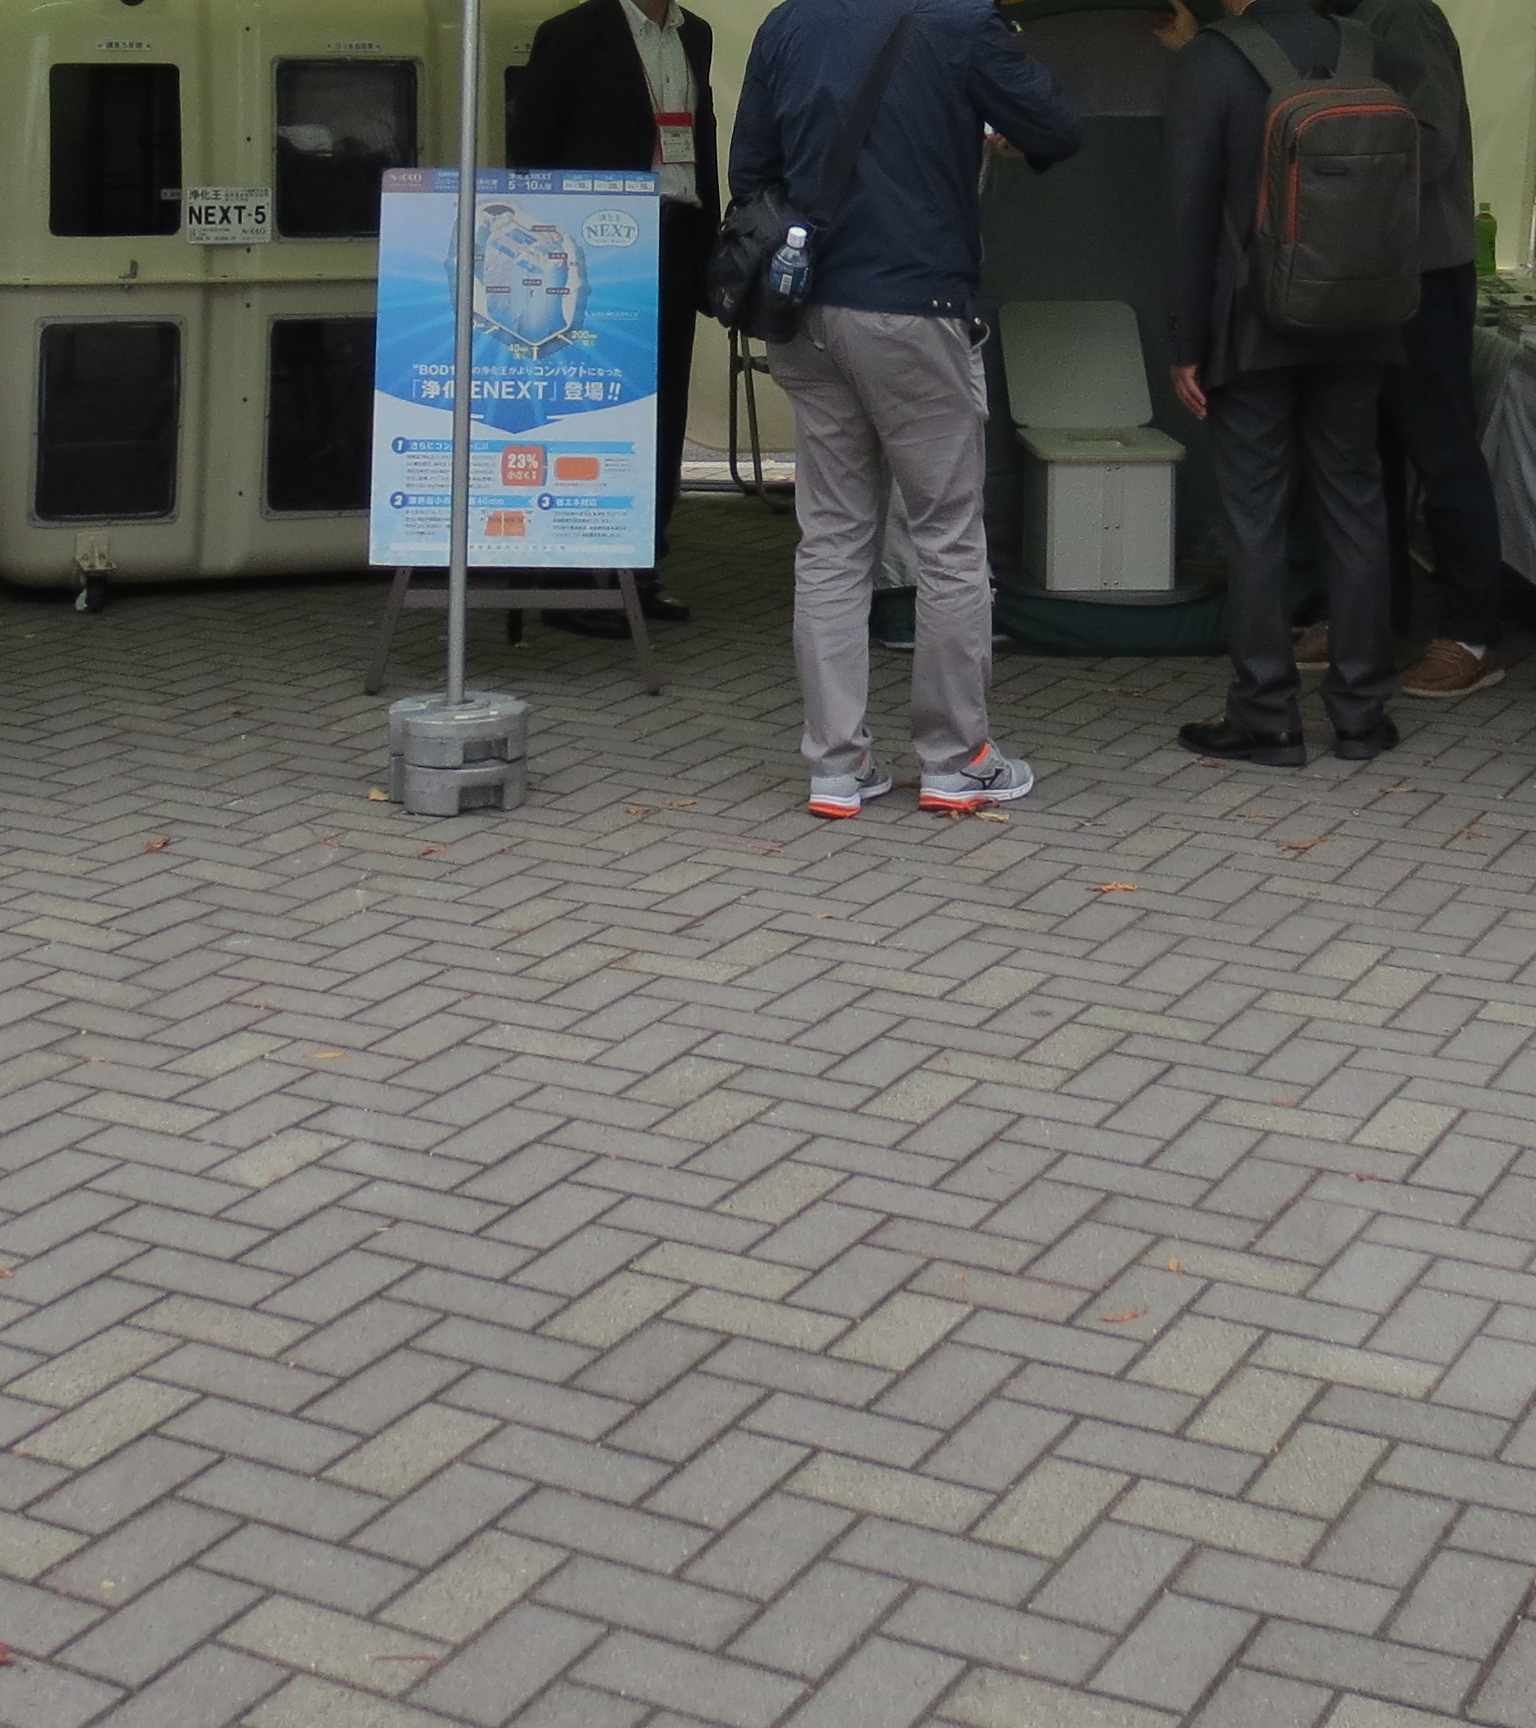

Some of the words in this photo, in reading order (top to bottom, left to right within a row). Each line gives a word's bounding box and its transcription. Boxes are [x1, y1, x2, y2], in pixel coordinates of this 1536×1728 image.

[188, 205, 266, 225] NEXT-5
[586, 223, 636, 239] NEXT
[507, 453, 539, 469] 23%
